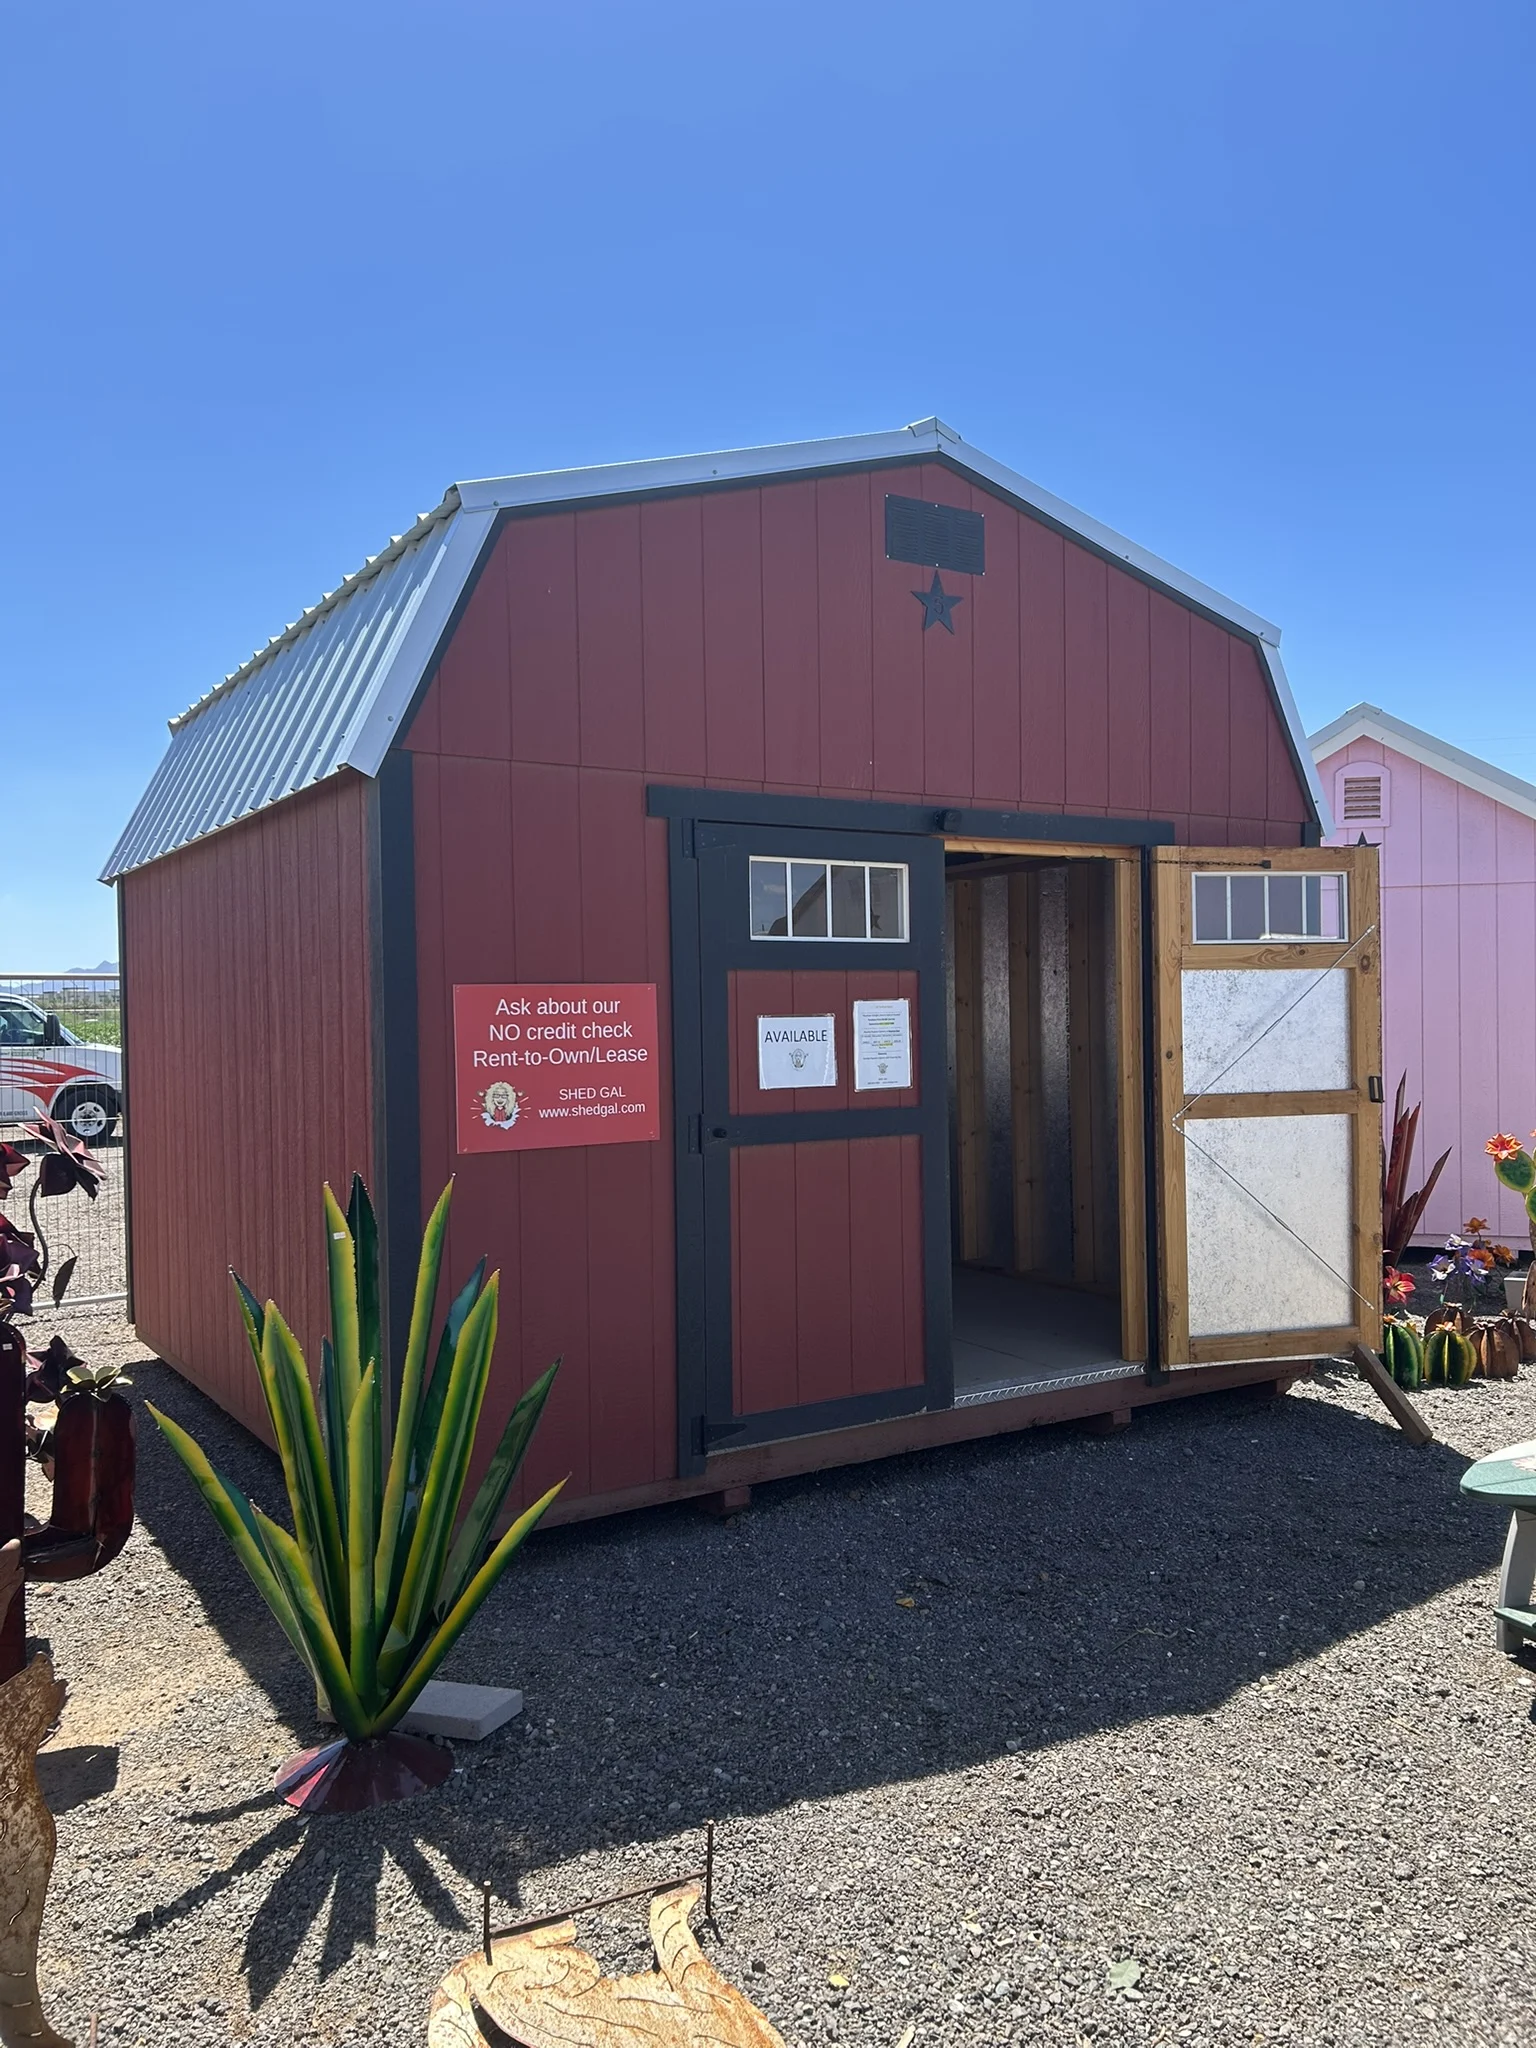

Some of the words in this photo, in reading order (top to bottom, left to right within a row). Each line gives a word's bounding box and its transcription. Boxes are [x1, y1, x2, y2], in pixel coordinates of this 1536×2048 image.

[496, 998, 531, 1016] Ask
[537, 997, 587, 1015] about
[592, 1000, 621, 1014] our
[490, 1023, 520, 1041] NO
[526, 1022, 577, 1040] credit
[581, 1021, 633, 1038] check
[764, 1030, 827, 1043] AVAILABLE
[473, 1046, 648, 1067] Rent-to-Own/Lease
[559, 1088, 596, 1100] SHED
[600, 1086, 626, 1098] GAL
[538, 1102, 646, 1118] www.shedgal.com
